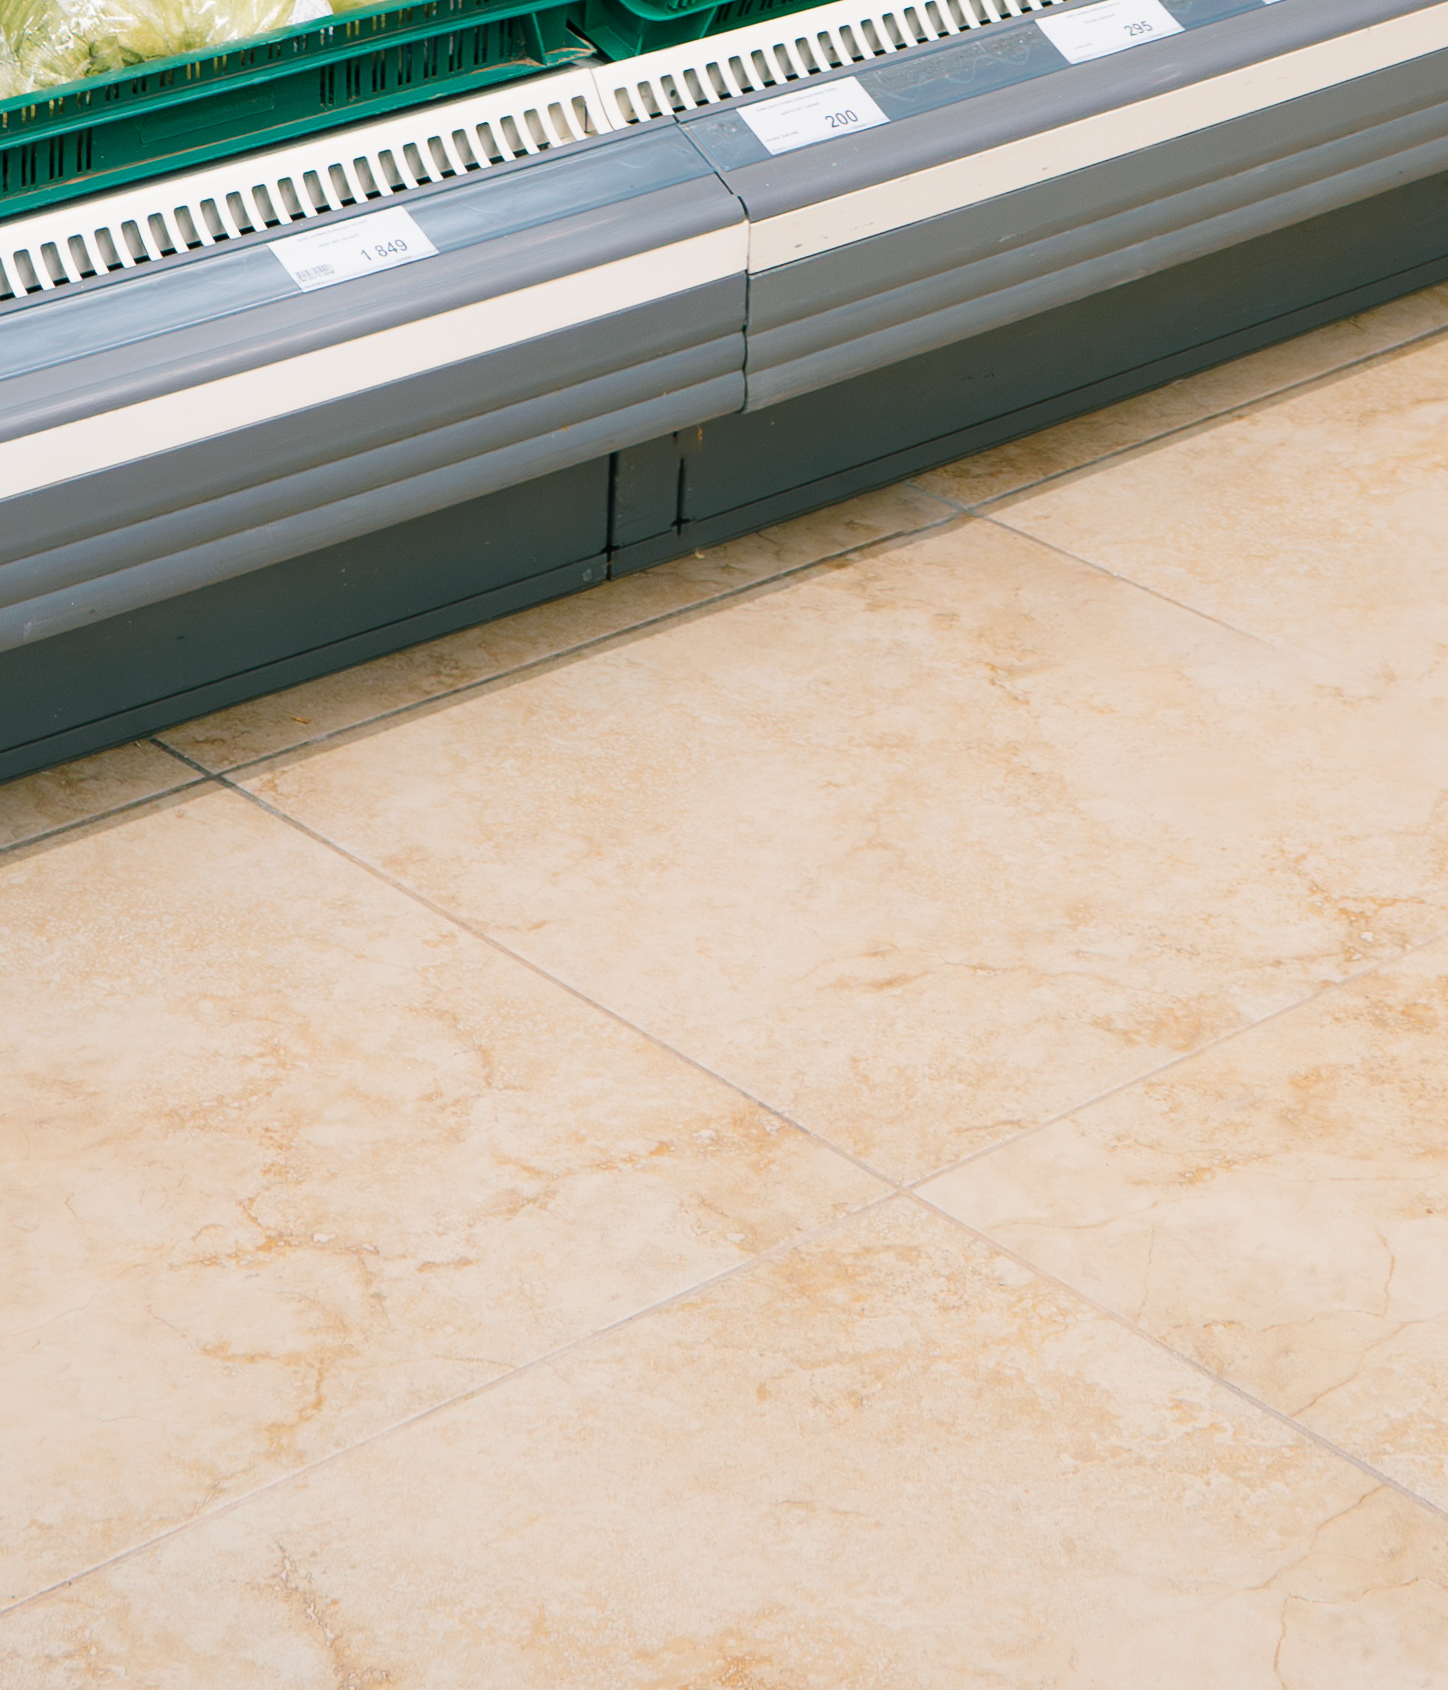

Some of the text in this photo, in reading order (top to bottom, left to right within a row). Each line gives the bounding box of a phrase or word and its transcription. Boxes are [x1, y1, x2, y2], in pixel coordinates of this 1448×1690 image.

[1124, 20, 1154, 36] 295
[825, 109, 859, 129] 200
[374, 238, 408, 258] 849
